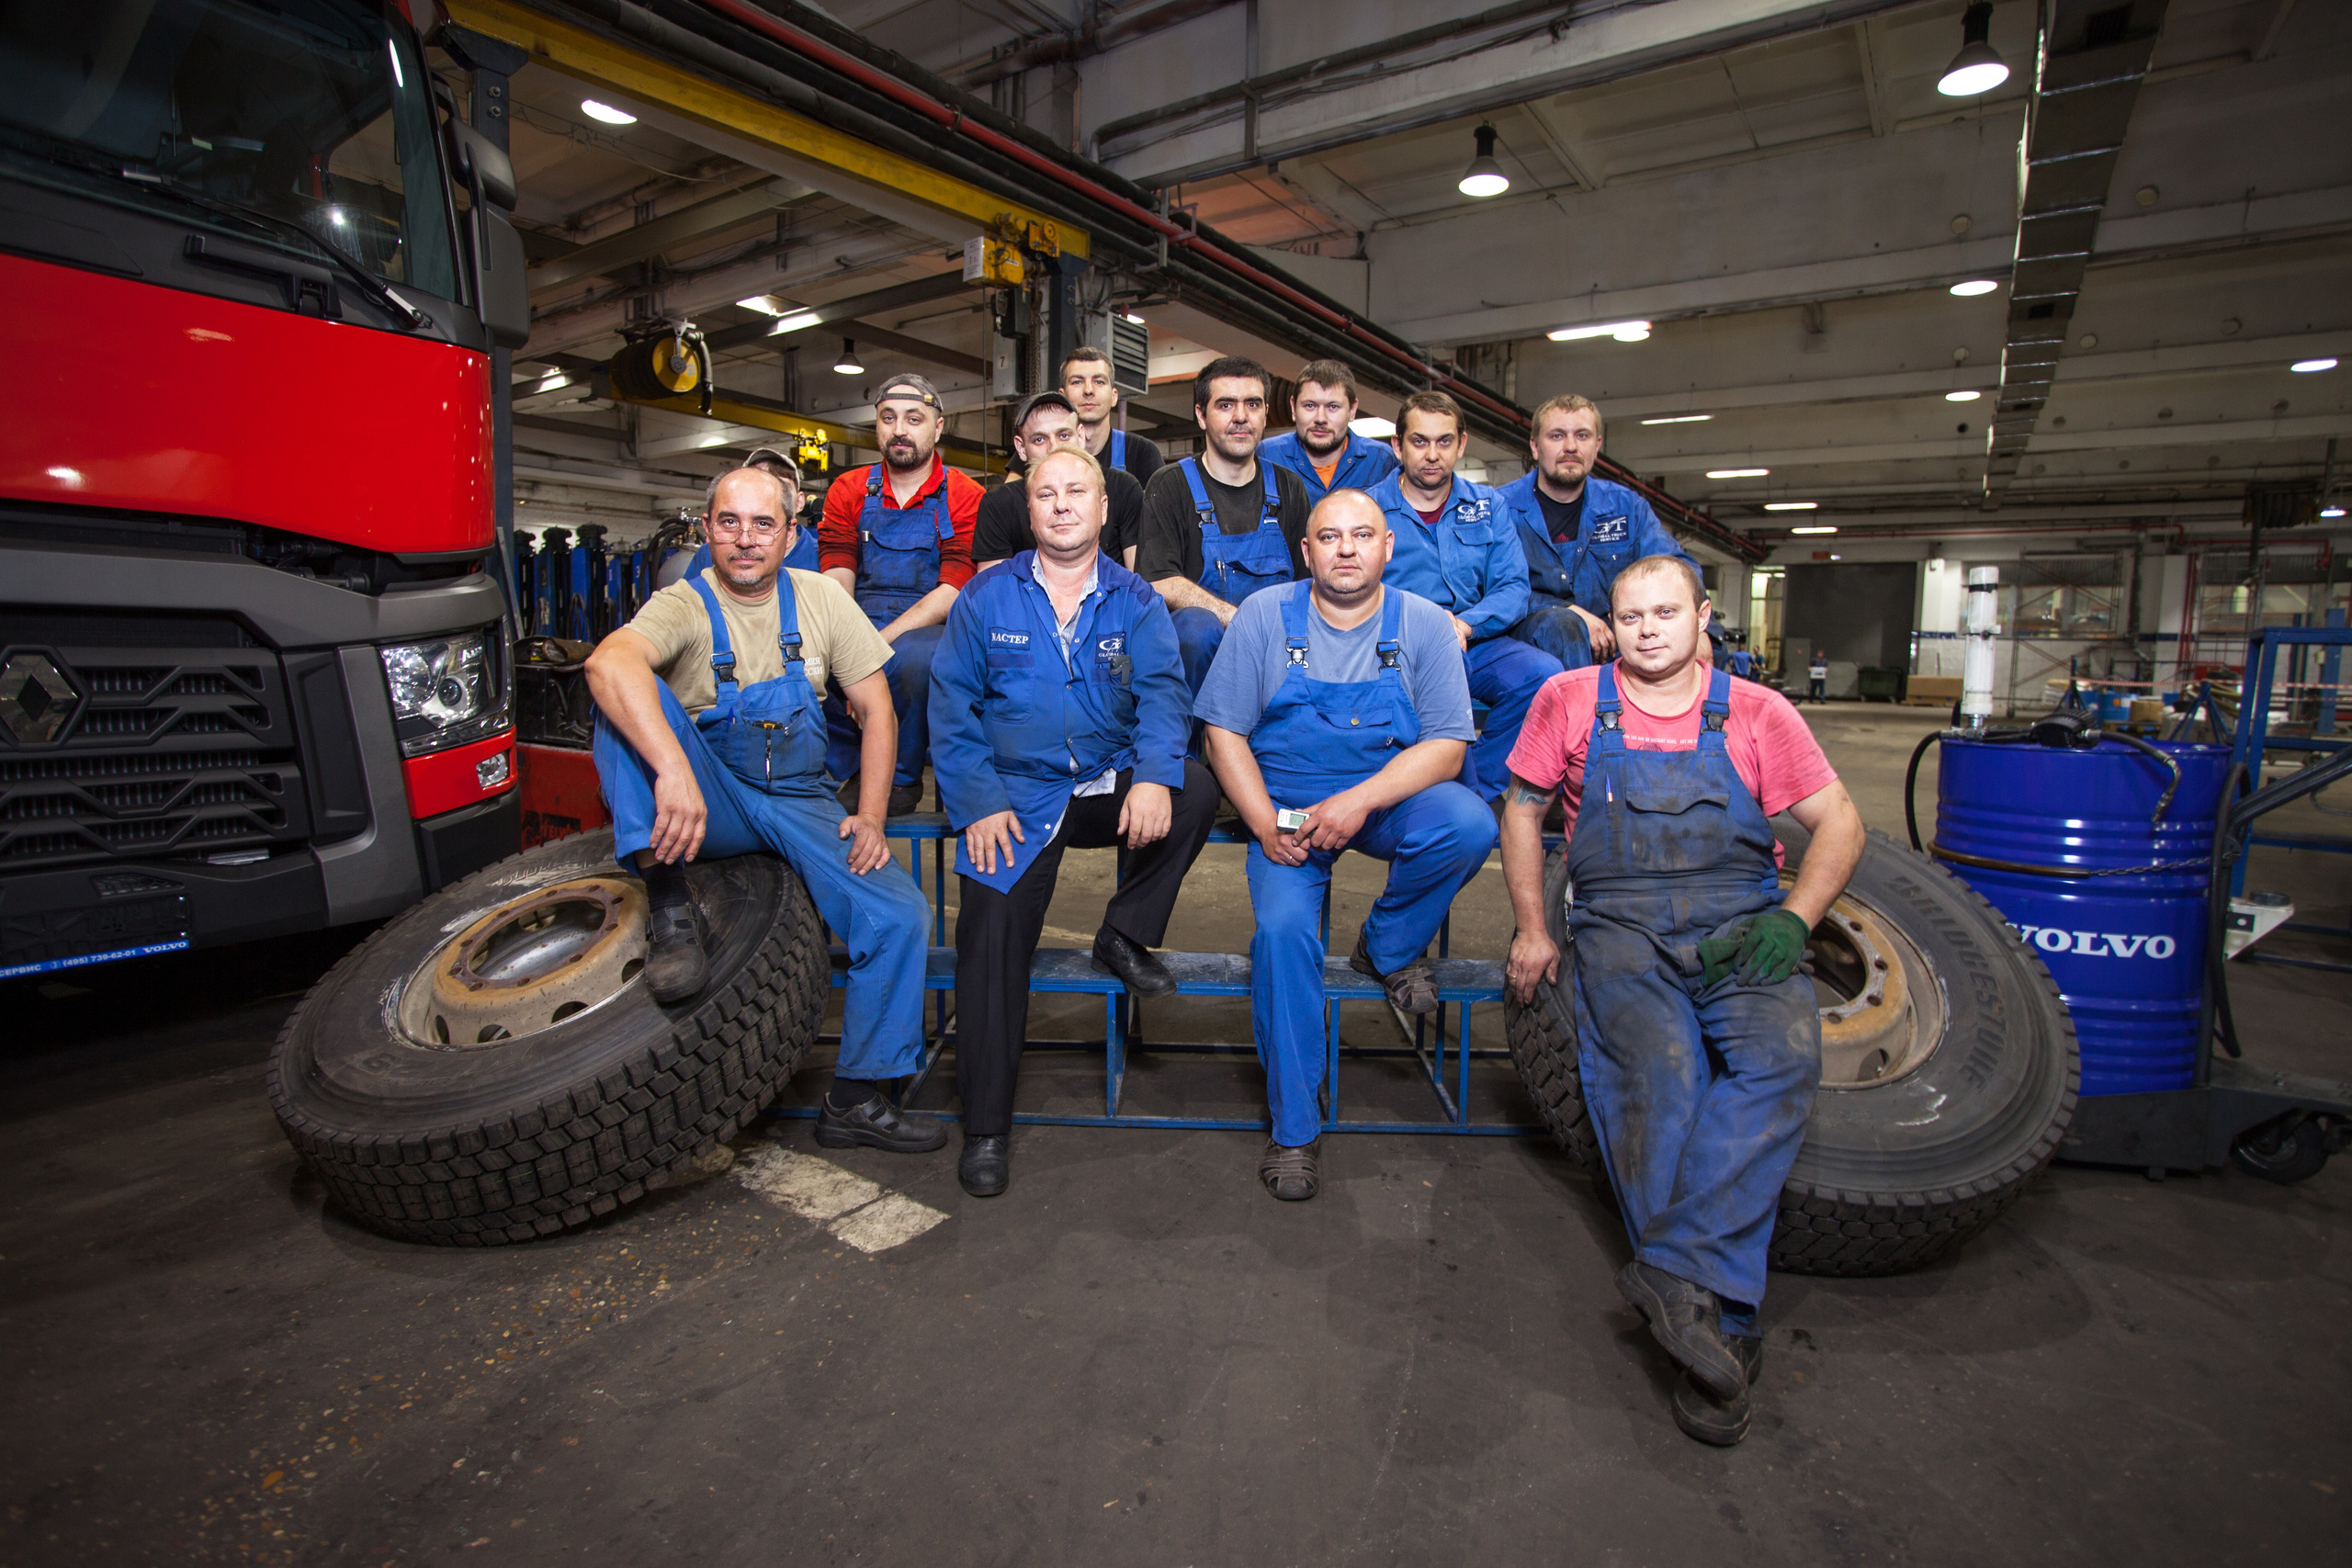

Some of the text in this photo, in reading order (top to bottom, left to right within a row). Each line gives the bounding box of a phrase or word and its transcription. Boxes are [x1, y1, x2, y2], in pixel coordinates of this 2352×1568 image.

[62, 956, 88, 967] (495)
[91, 949, 136, 963] 739-62-01
[142, 942, 187, 953] VOLVO
[1887, 875, 2007, 1094] BRIDGESTONE
